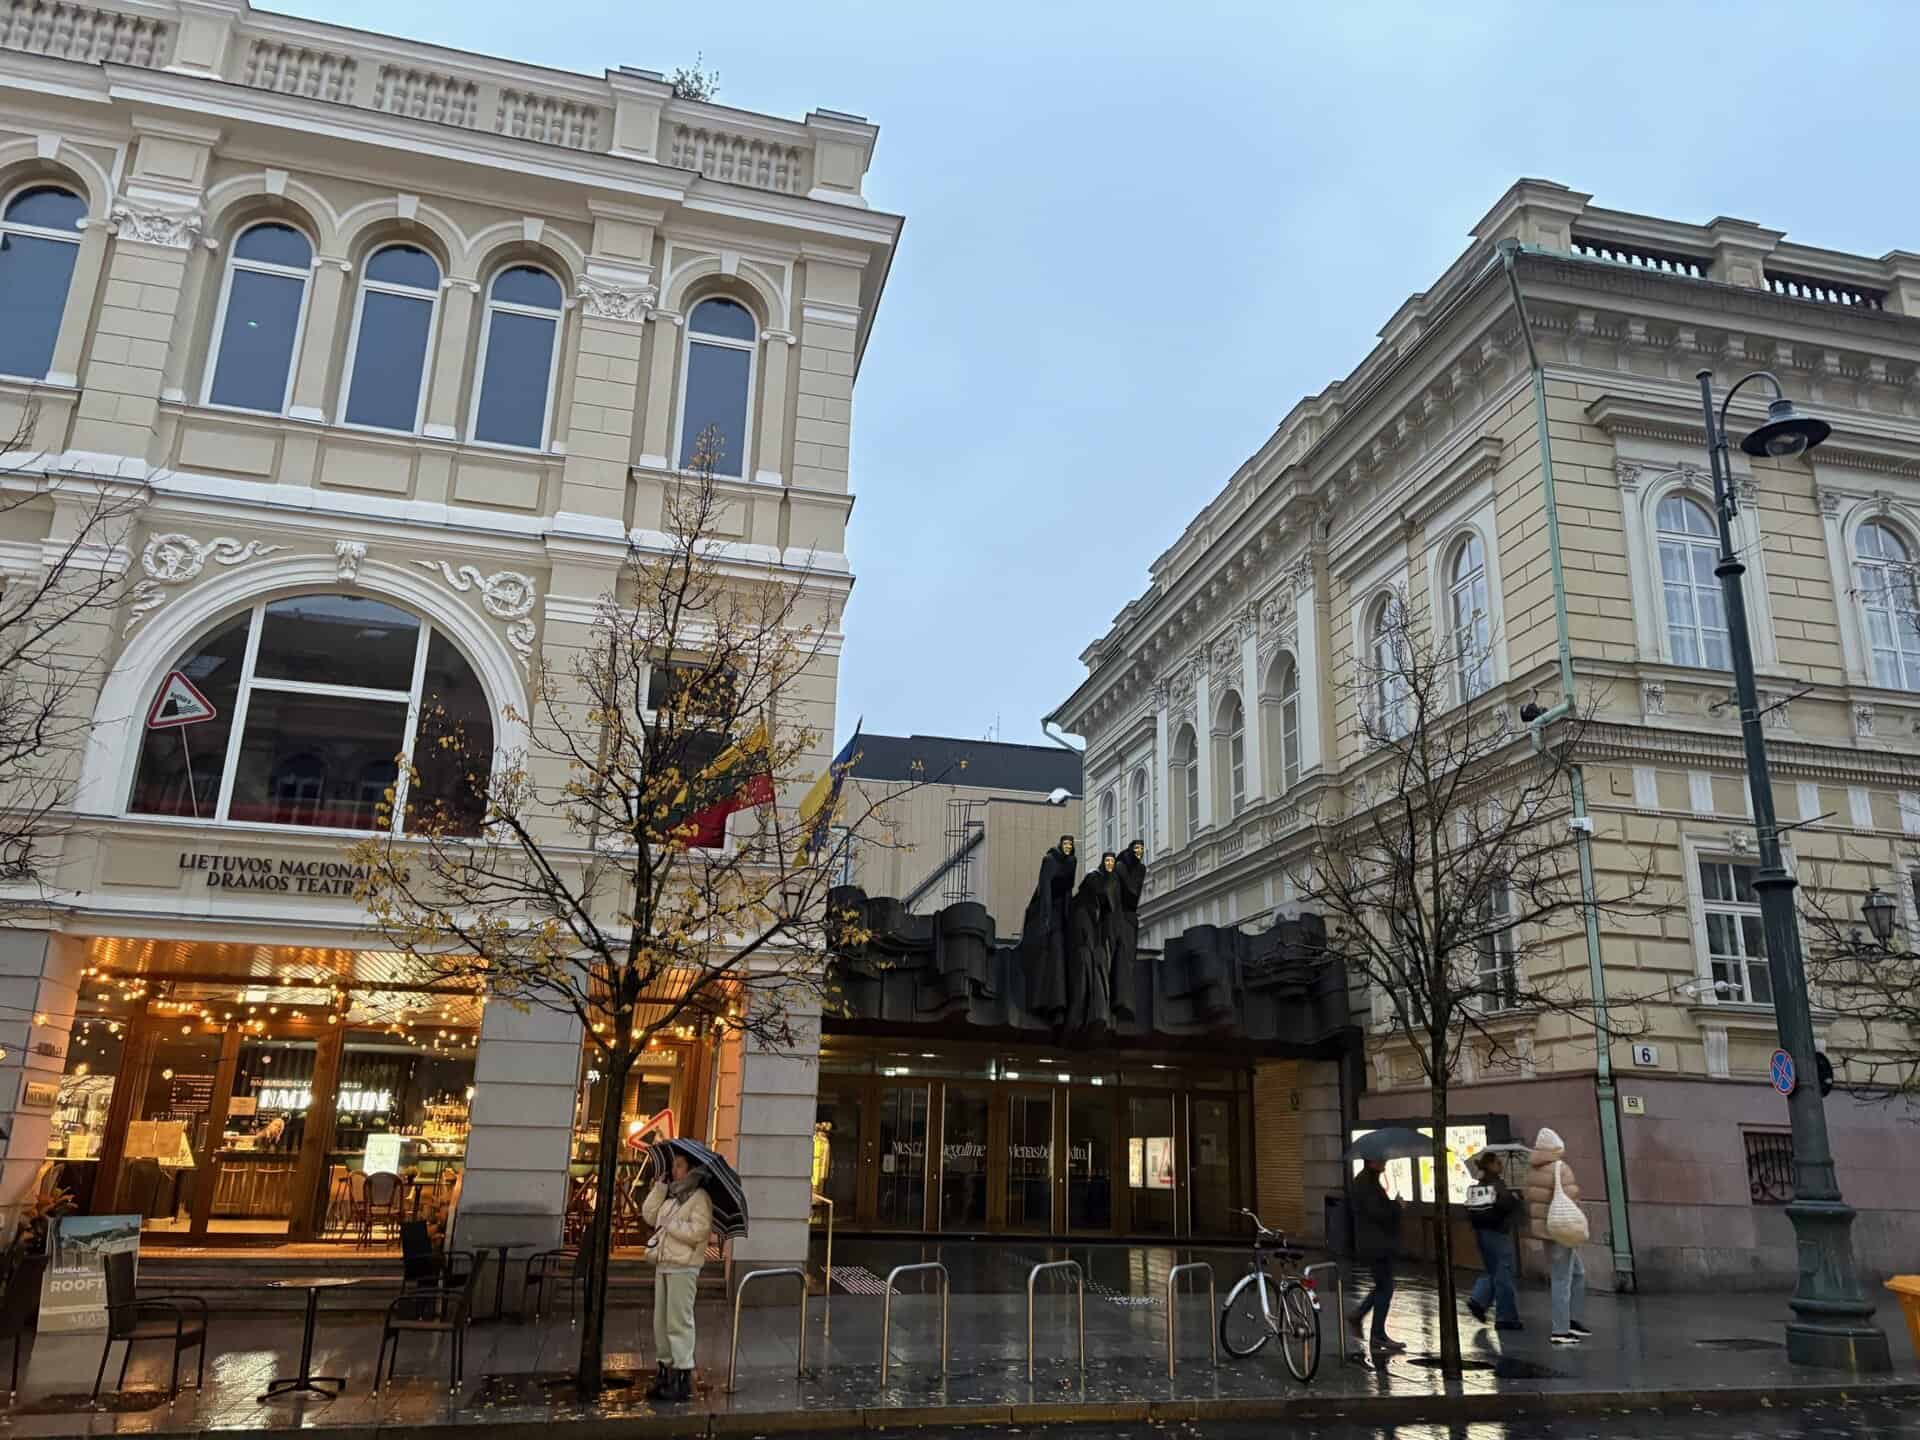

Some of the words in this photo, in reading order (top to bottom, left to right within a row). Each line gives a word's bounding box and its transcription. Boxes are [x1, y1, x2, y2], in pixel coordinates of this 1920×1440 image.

[179, 853, 272, 873] LIETUVOS
[280, 860, 411, 883] NACIONALS
[206, 871, 289, 892] DRAMOS
[296, 878, 378, 897] TEATRS
[1641, 1047, 1651, 1063] 6
